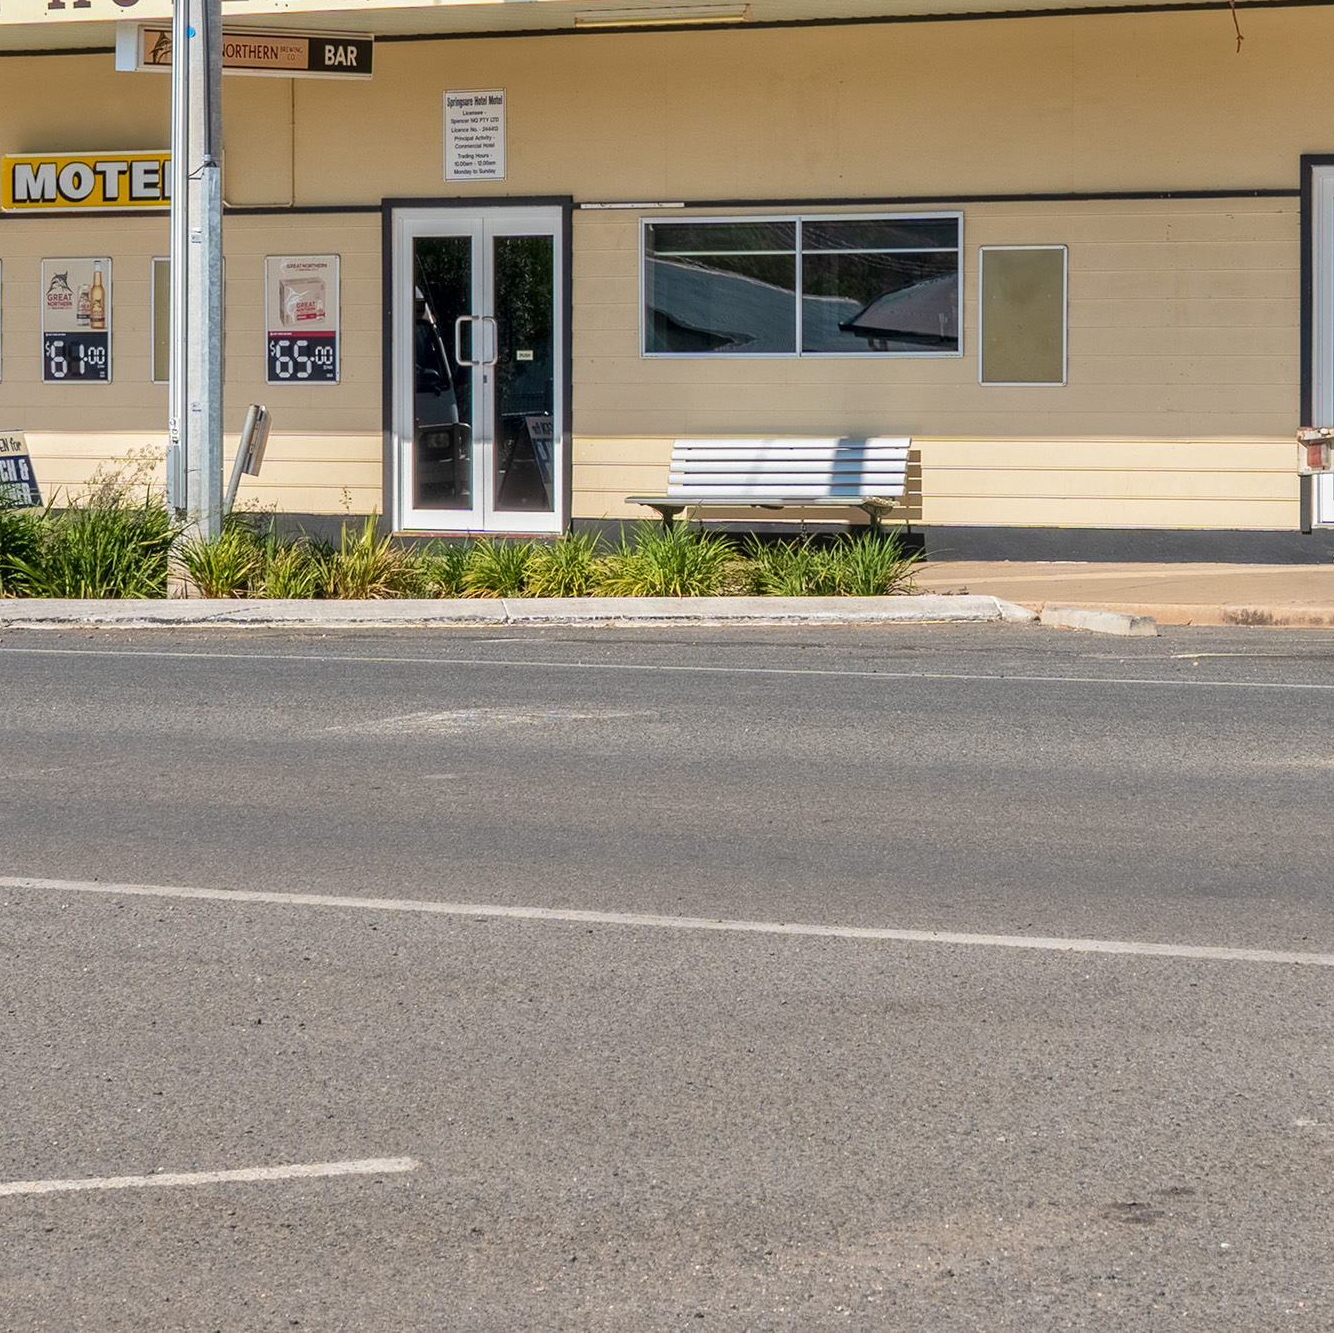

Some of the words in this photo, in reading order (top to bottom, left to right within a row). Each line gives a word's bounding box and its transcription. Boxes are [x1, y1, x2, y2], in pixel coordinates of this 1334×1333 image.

[280, 45, 303, 54] BREWING
[324, 45, 358, 67] BAR
[447, 97, 473, 109] Springsure
[474, 96, 487, 106] Hotel
[488, 95, 503, 105] Motel
[47, 294, 73, 302] GREAT
[296, 301, 316, 309] GREAT
[9, 436, 22, 452] for
[18, 458, 30, 481] &
